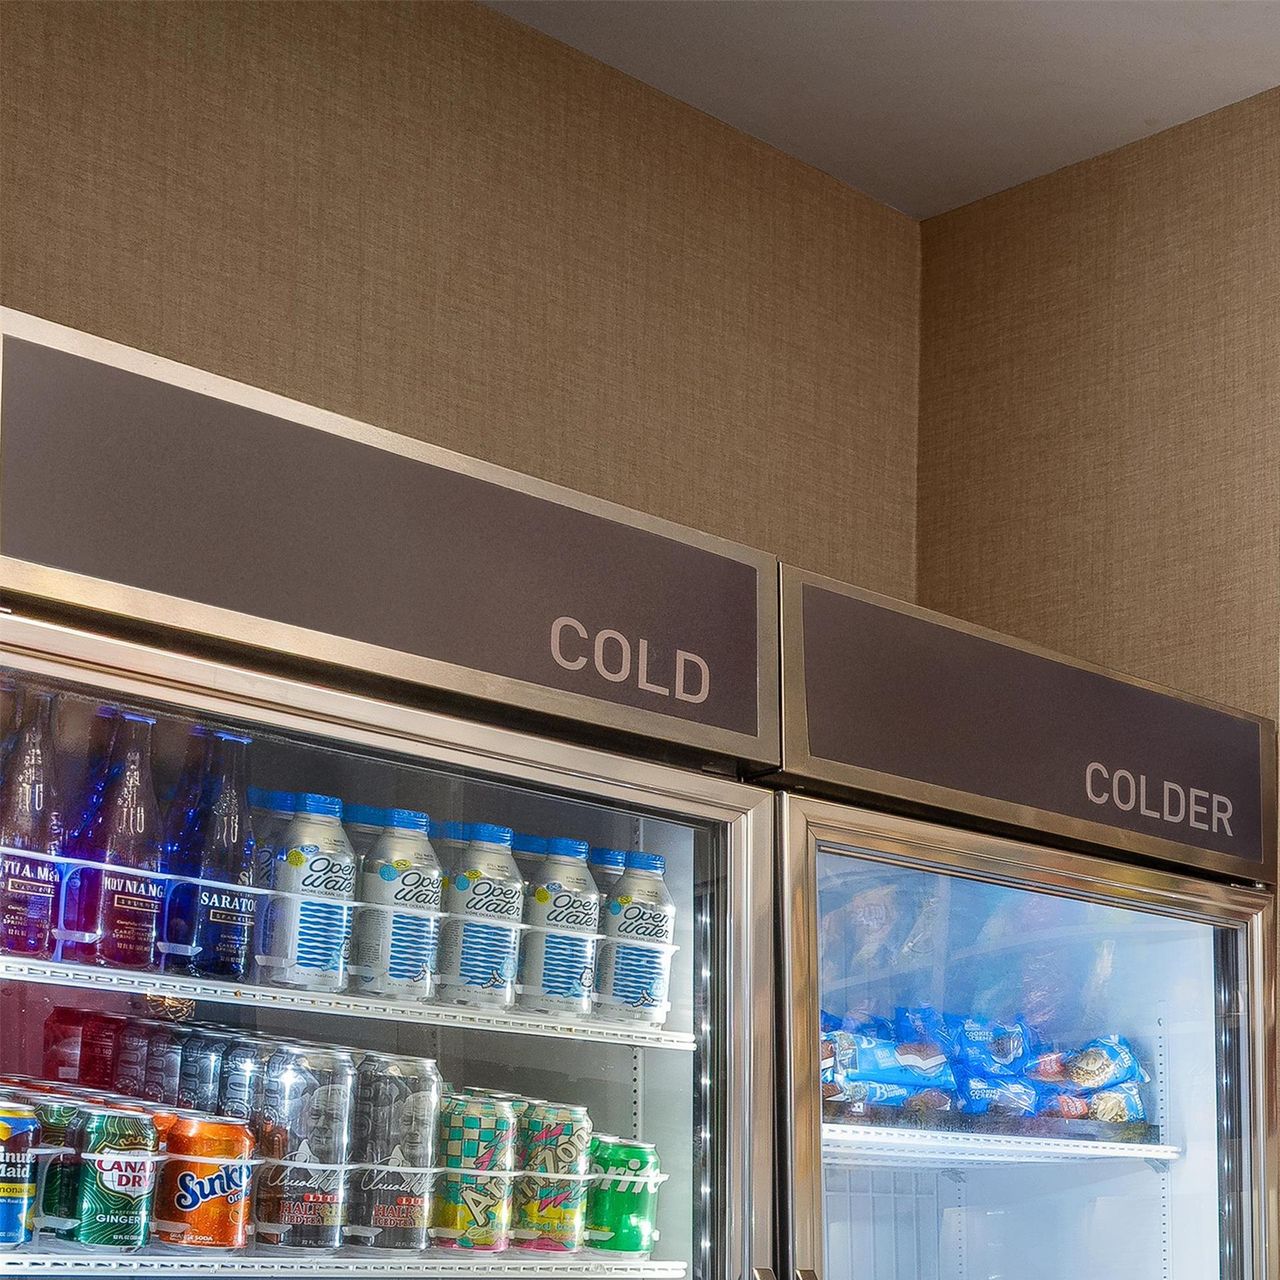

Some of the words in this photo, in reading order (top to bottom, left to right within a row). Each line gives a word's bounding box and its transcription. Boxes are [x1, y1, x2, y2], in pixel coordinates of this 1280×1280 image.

[550, 616, 710, 704] COLD
[1085, 762, 1233, 836] COLDER
[472, 882, 520, 903] Open
[465, 895, 520, 915] Water
[623, 906, 669, 925] Open
[96, 1214, 139, 1224] GINGER
